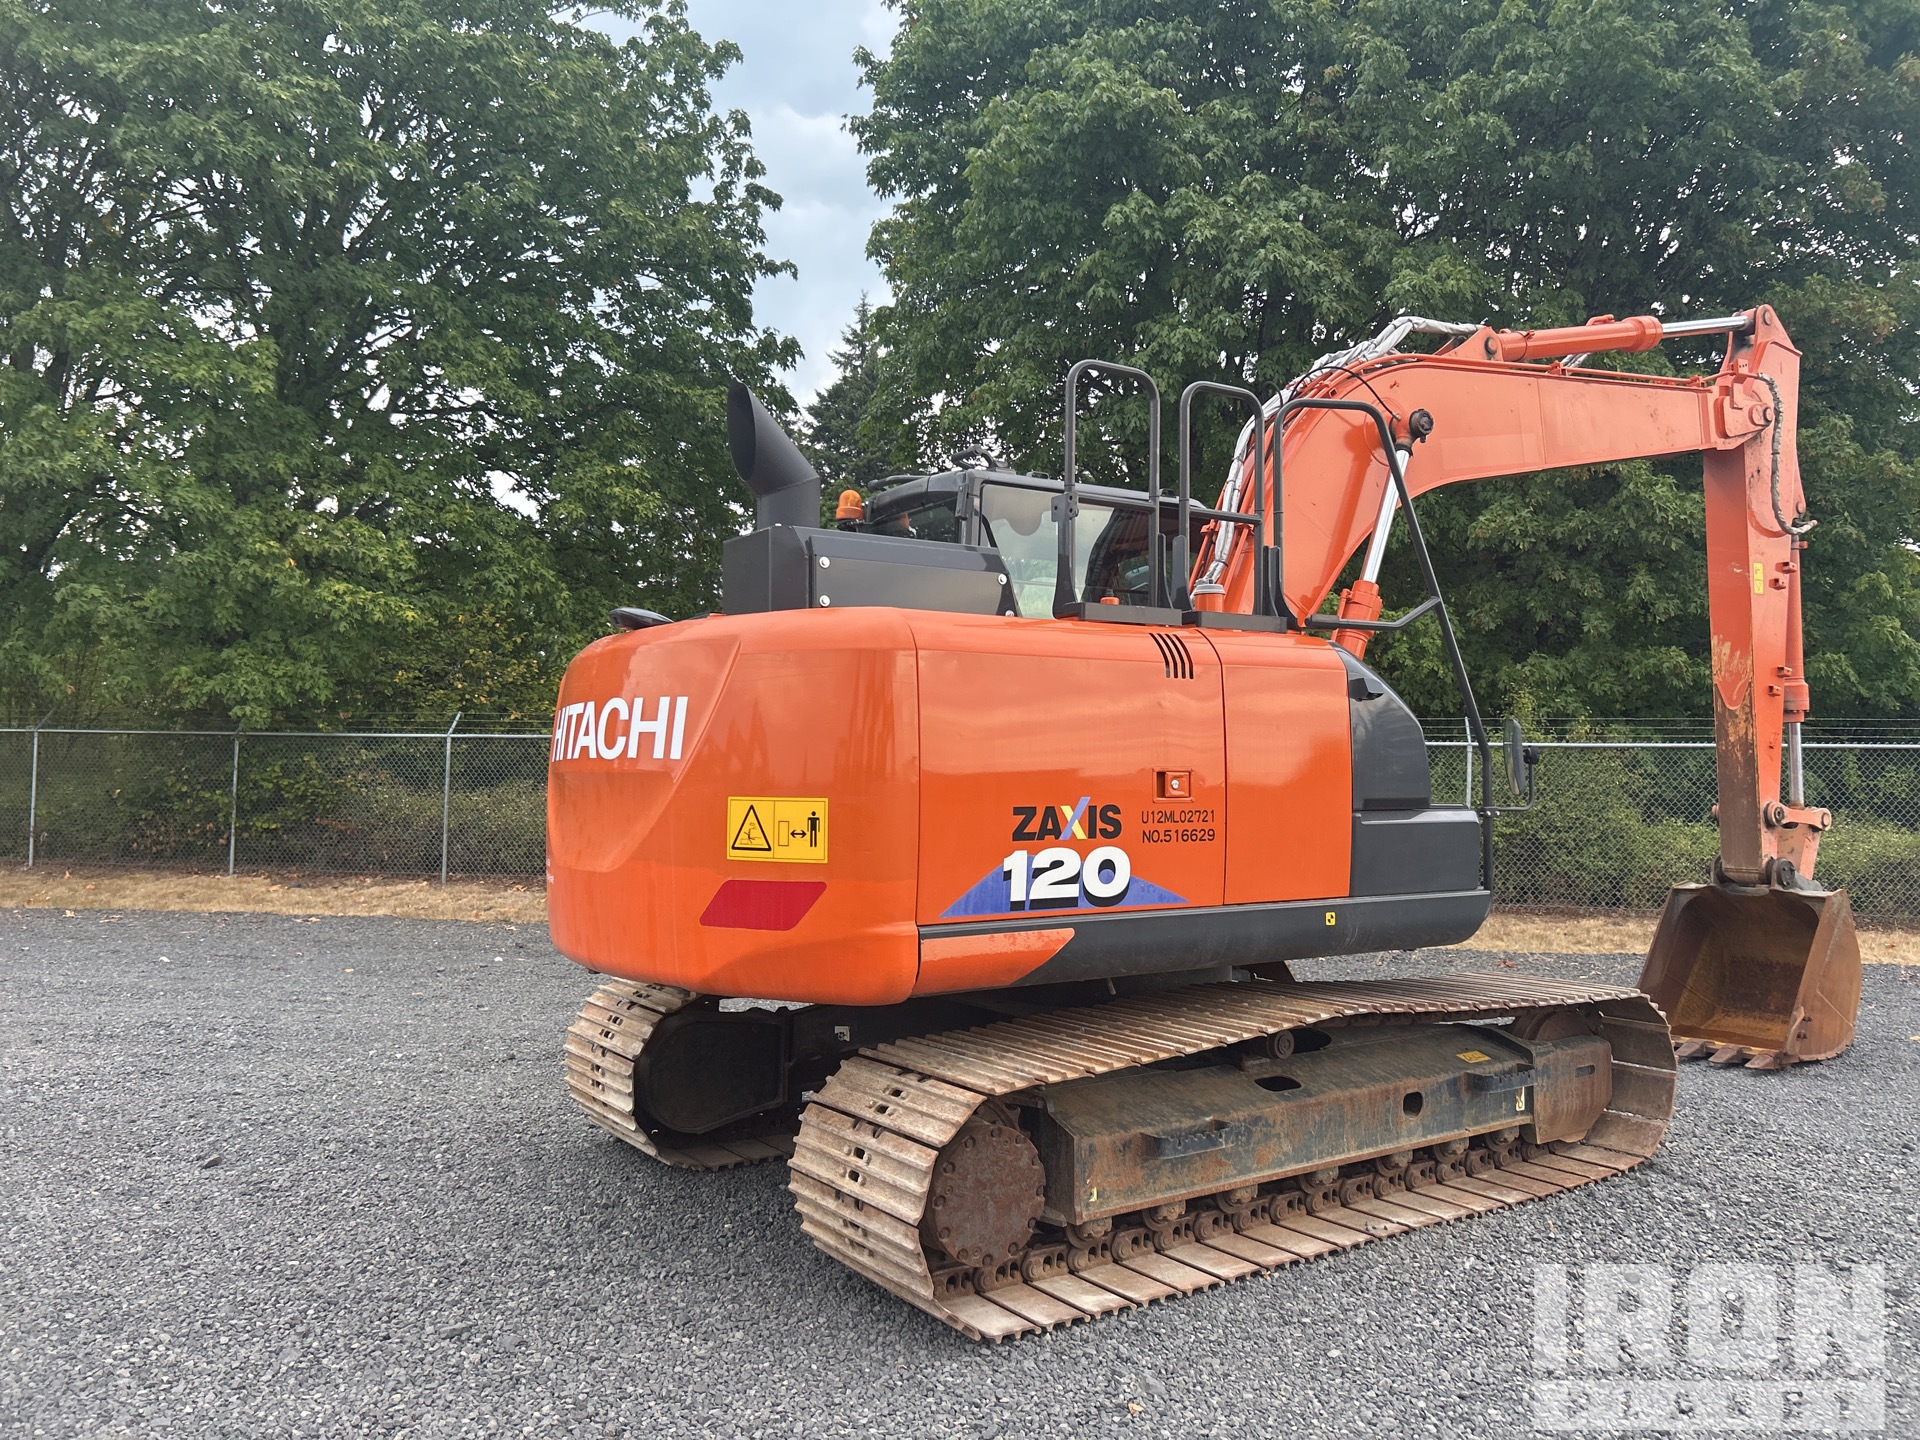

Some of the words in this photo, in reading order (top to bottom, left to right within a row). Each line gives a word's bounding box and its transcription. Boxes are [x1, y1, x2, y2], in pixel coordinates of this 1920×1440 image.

[552, 696, 688, 762] HITACHI
[1012, 796, 1122, 841] ZAXIS
[1141, 809, 1216, 825] U12ML02721
[1142, 828, 1216, 844] NO.516629
[1003, 846, 1131, 911] 120
